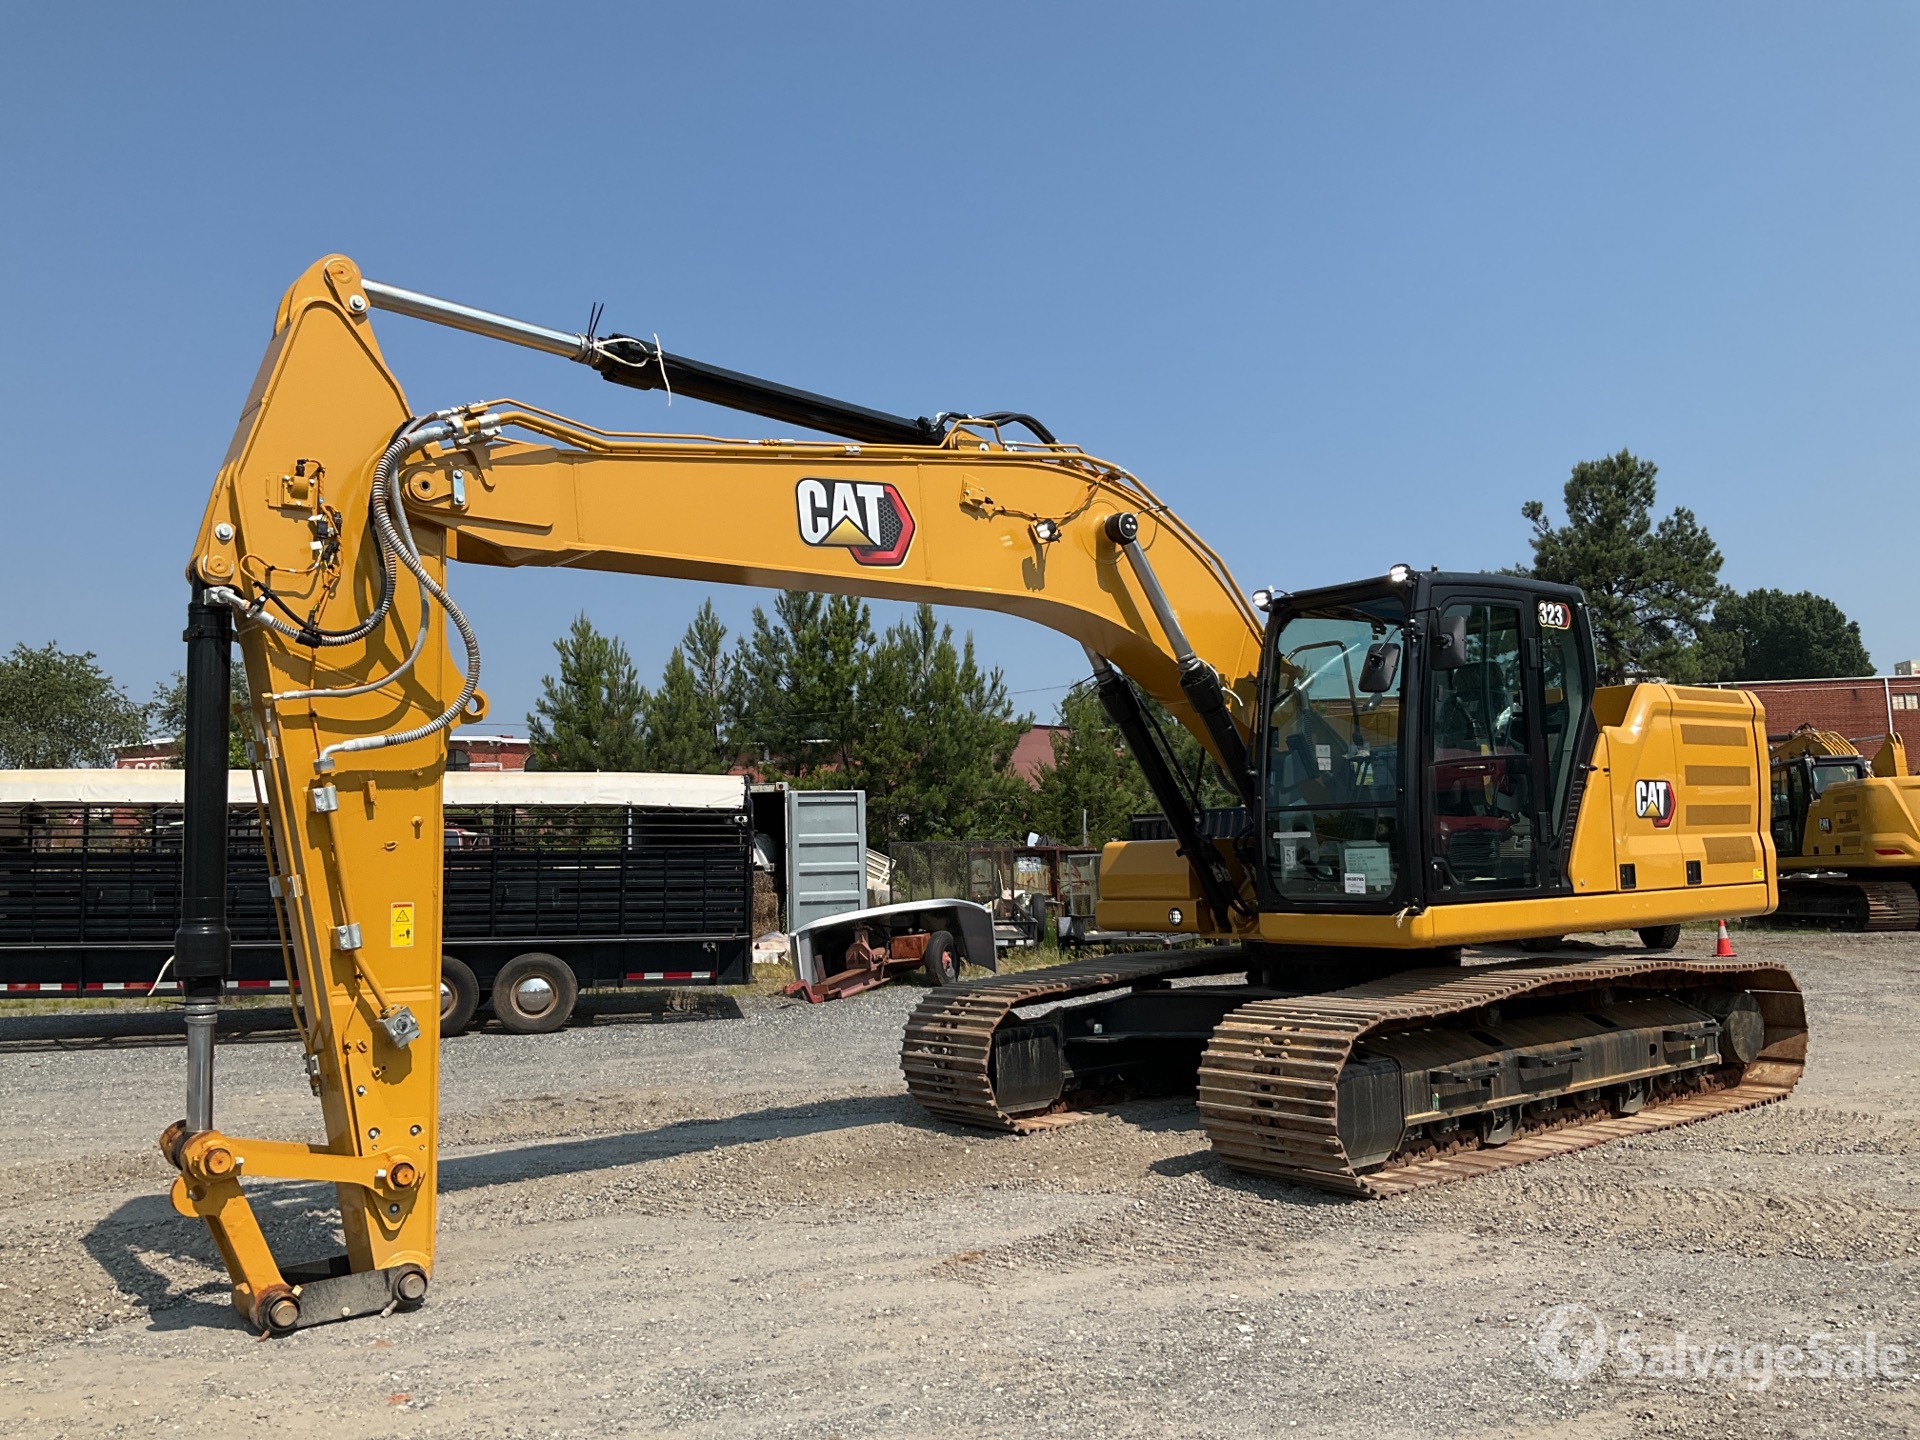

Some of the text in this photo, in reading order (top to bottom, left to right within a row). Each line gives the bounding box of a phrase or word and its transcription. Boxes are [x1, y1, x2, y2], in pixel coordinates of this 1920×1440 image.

[797, 479, 884, 546] CAT
[1539, 602, 1563, 626] 323
[1635, 780, 1667, 817] CAT
